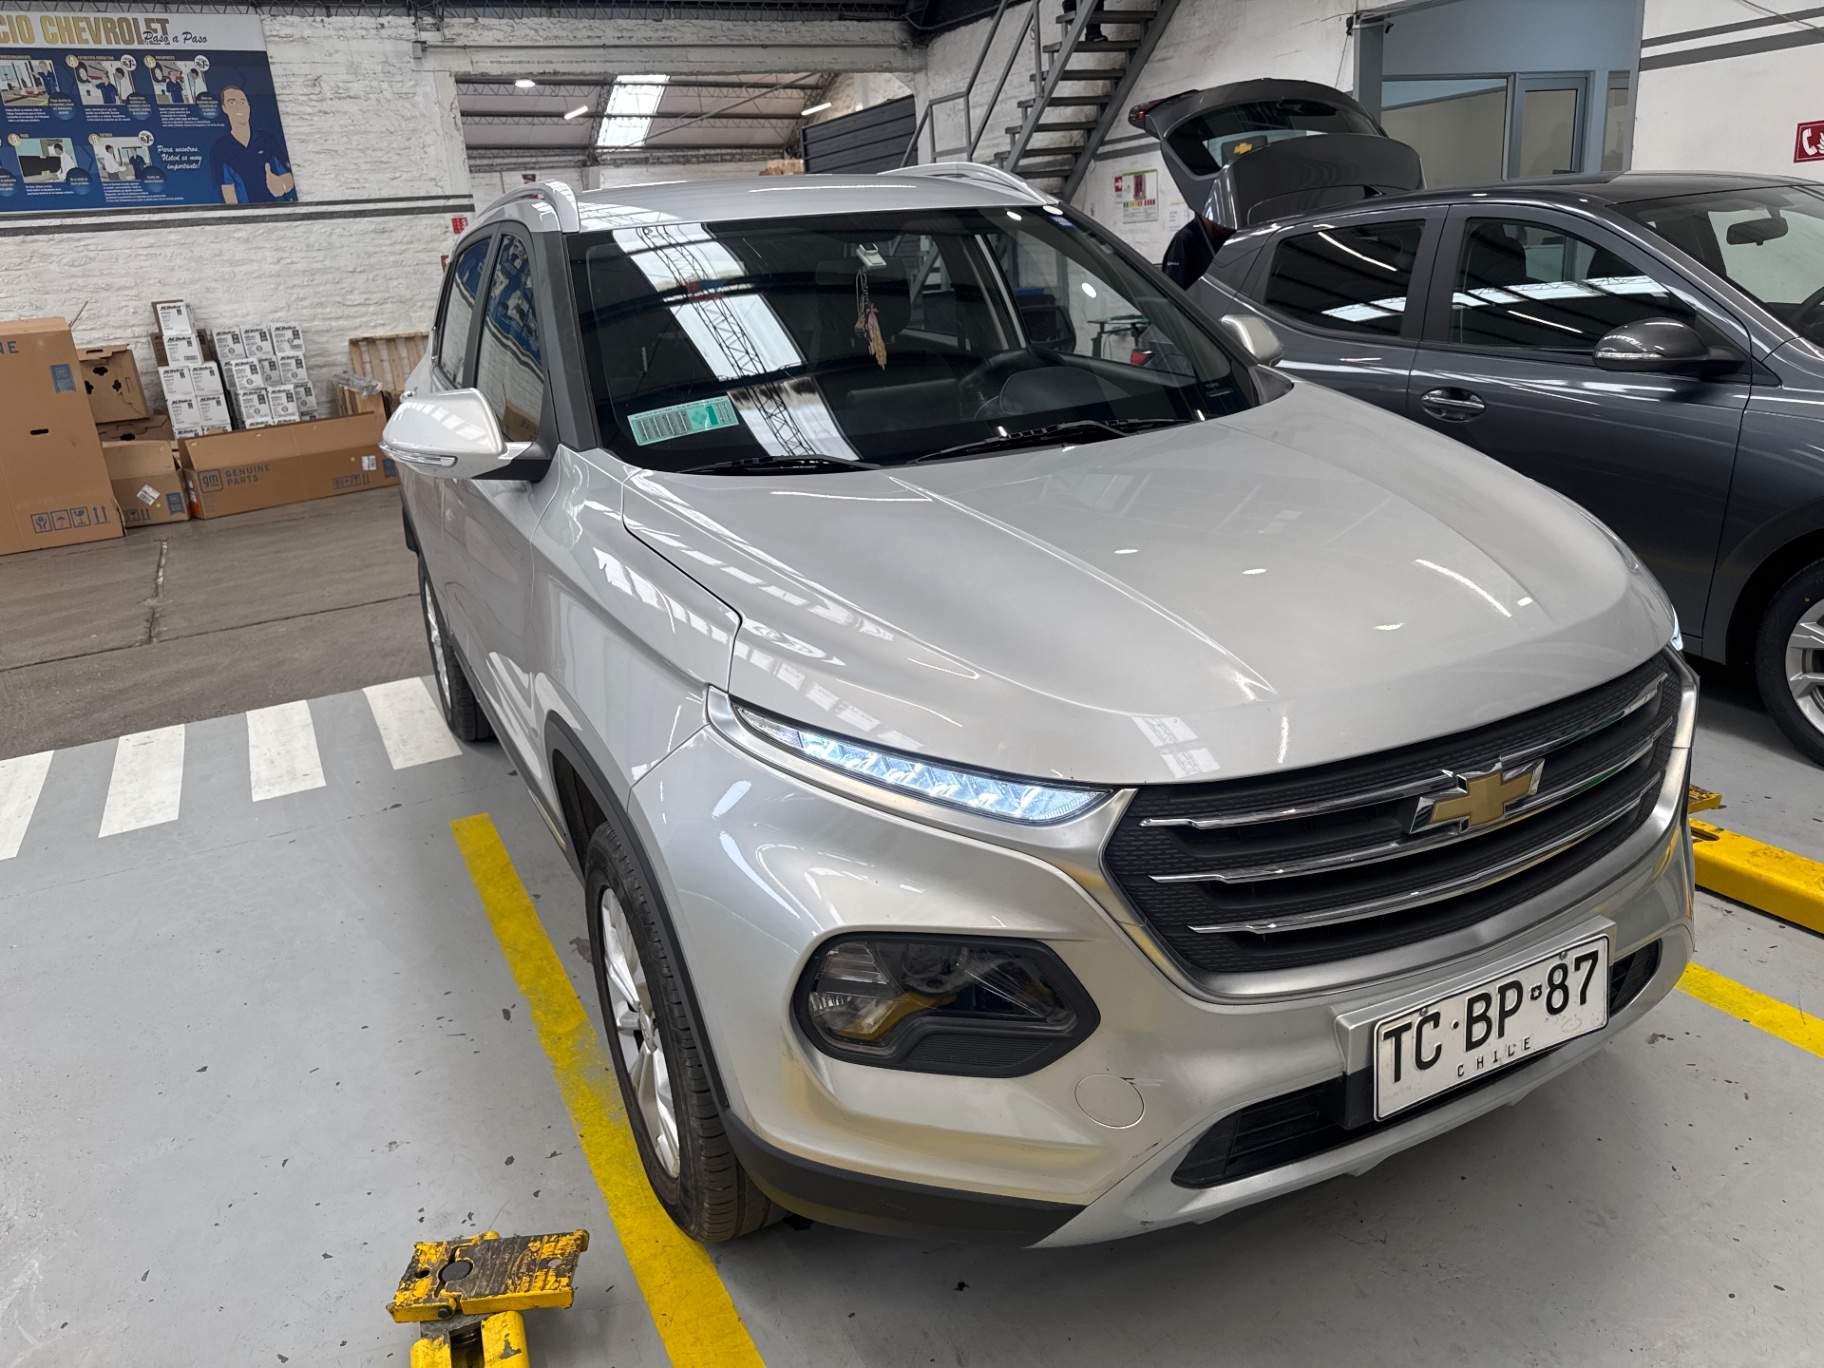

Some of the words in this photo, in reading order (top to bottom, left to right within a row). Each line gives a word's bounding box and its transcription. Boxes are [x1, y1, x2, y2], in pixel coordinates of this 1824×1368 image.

[40, 15, 170, 46] CHEVROLET
[143, 31, 168, 45] Paso
[172, 35, 180, 43] a
[182, 32, 209, 45] Paso
[225, 464, 271, 478] GENUINE
[202, 474, 219, 489] gm
[227, 474, 259, 486] PARTS
[1457, 1037, 1532, 1078] CHILE
